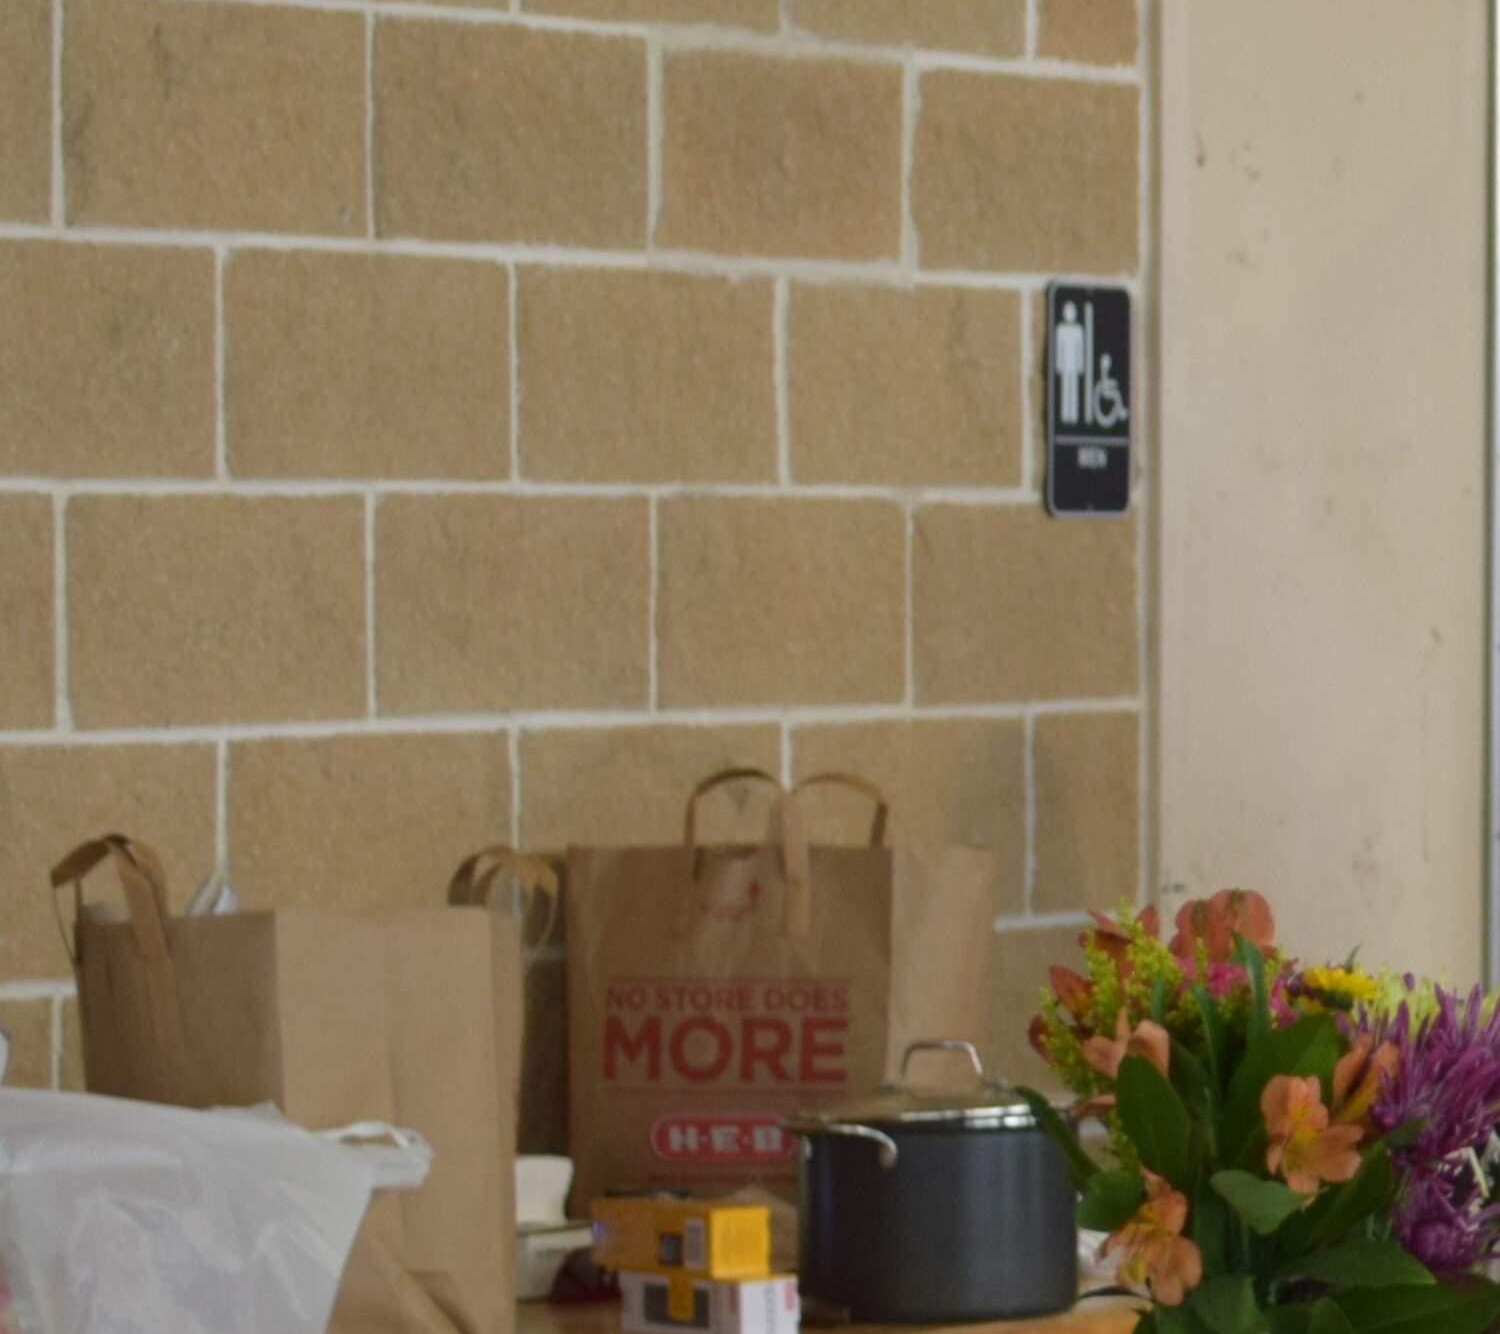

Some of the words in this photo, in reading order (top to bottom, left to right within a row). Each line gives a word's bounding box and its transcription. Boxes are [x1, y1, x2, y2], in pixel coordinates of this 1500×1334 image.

[607, 987, 648, 1011] NO
[656, 987, 749, 1011] STORE
[764, 987, 848, 1012] DOES
[603, 1017, 848, 1084] MORE
